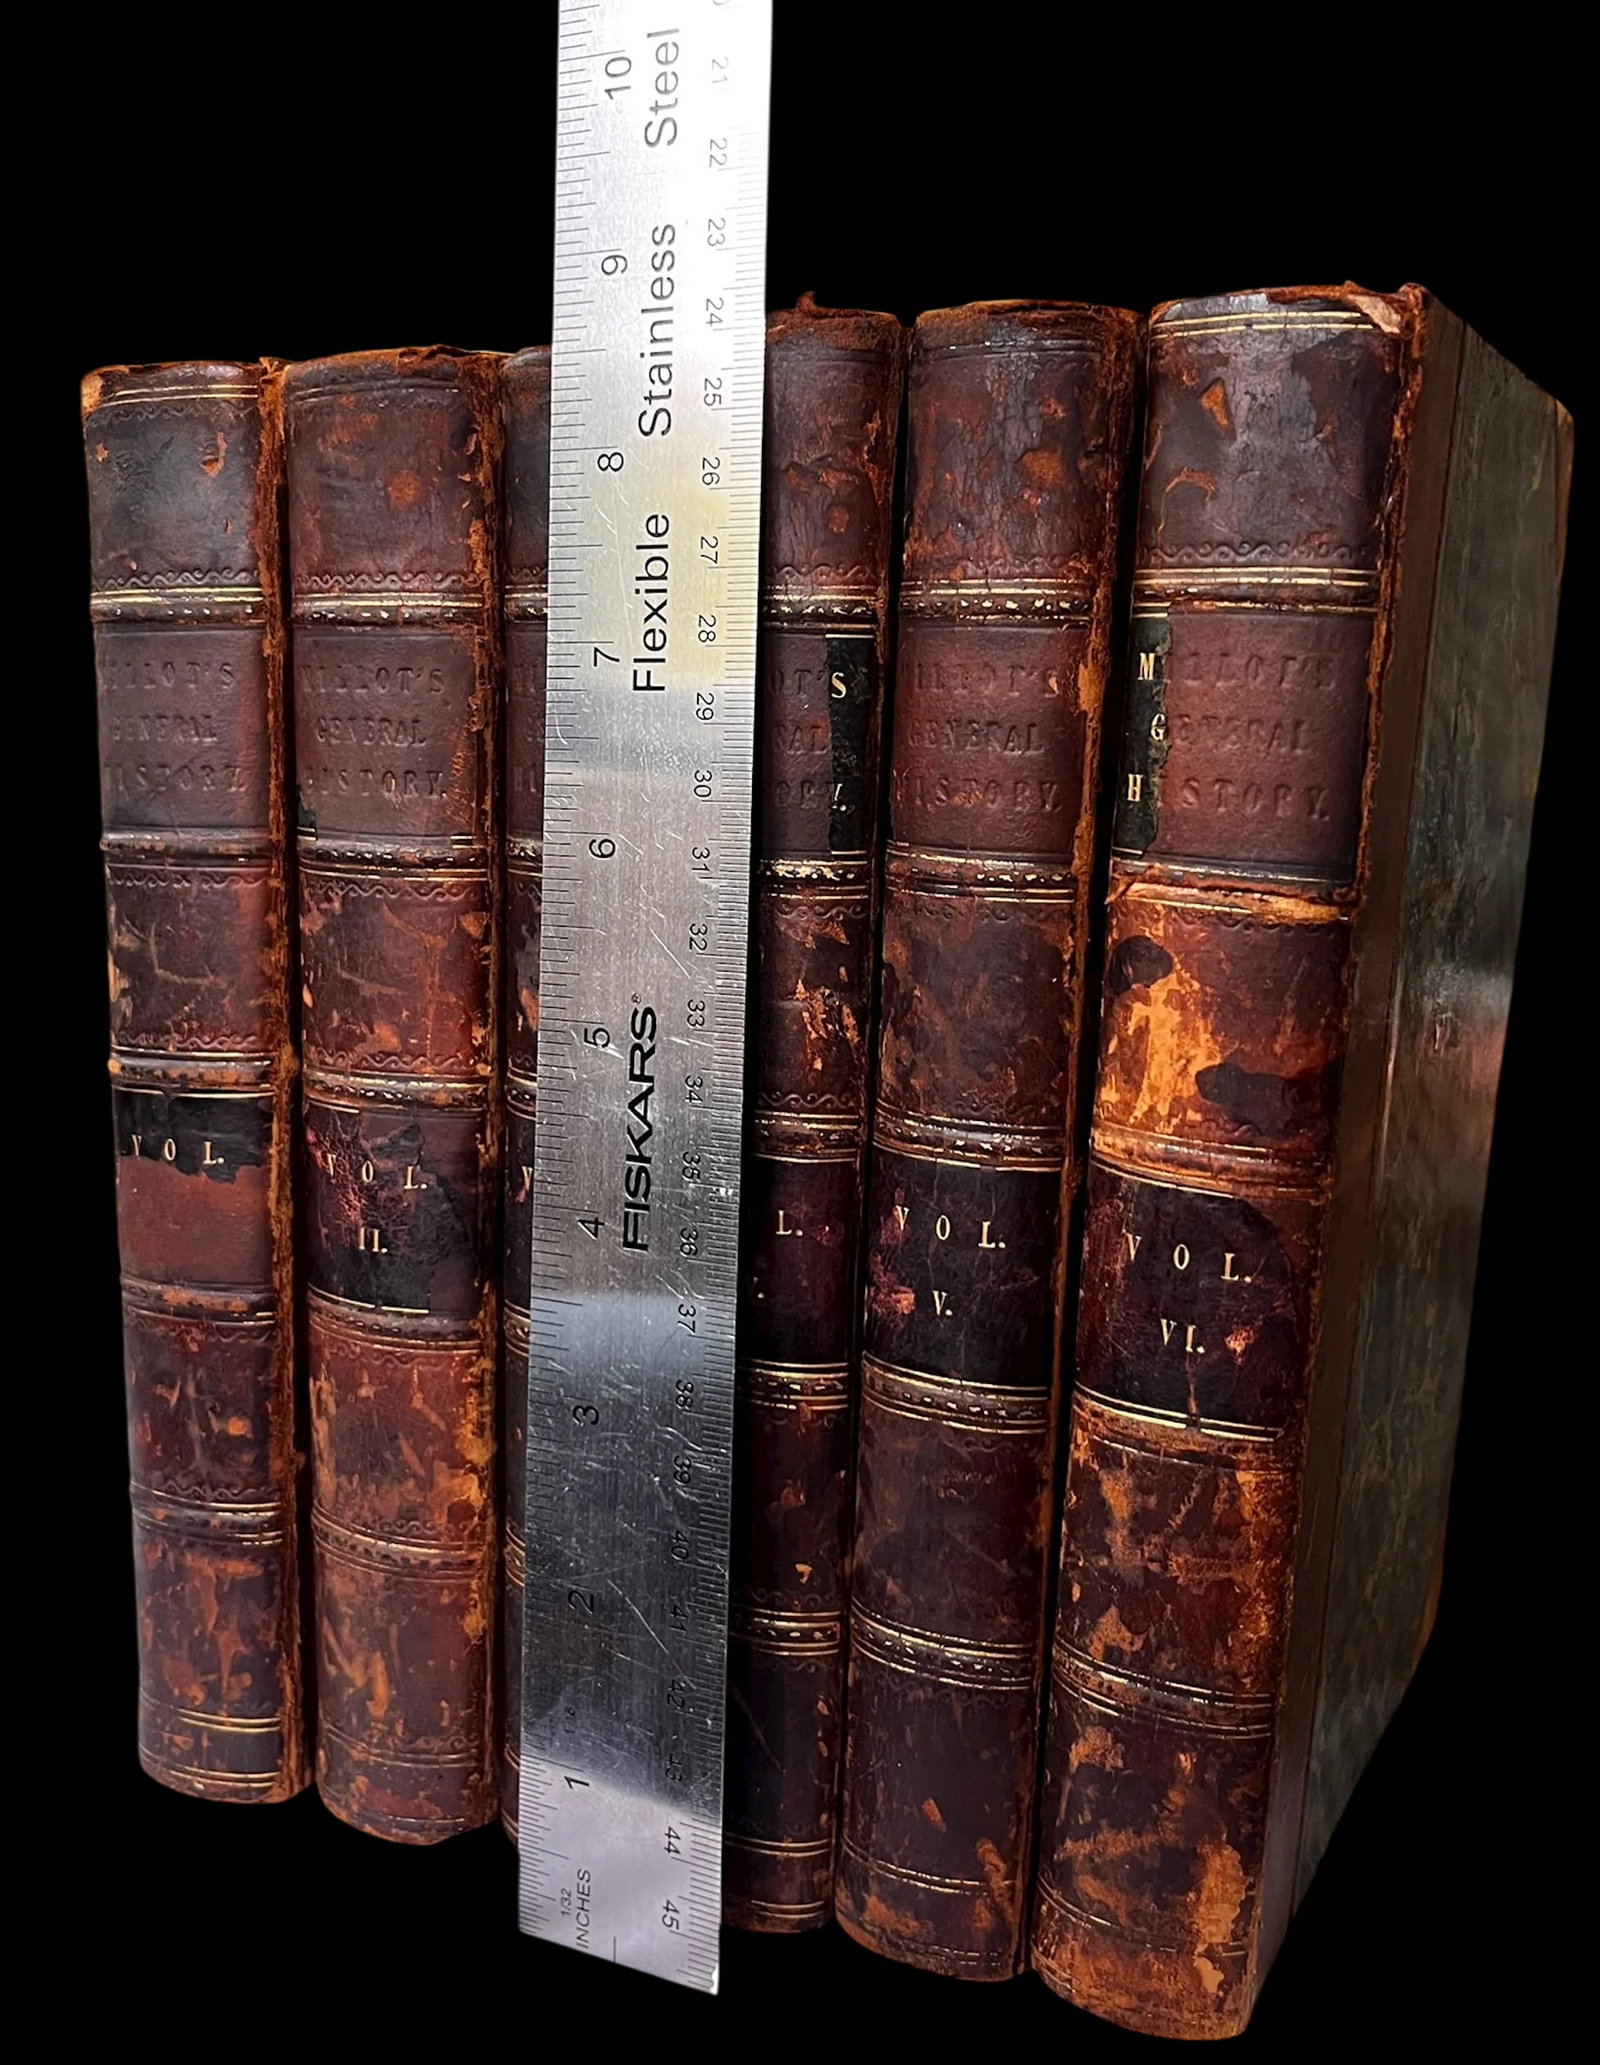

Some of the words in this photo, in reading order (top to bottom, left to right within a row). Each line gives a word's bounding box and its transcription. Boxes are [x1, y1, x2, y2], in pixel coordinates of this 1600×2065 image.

[604, 55, 631, 100] 10
[711, 56, 729, 84] 21
[644, 28, 679, 148] Steel
[708, 137, 728, 168] 22
[707, 217, 726, 247] 23
[600, 254, 627, 276] 9
[705, 297, 724, 327] 24
[638, 224, 676, 436] Stainless
[703, 377, 722, 407] 25
[597, 452, 624, 472] 8
[702, 457, 720, 486] 26
[700, 535, 718, 564] 27
[632, 513, 669, 692] Flexible
[698, 614, 716, 643] 28
[593, 647, 620, 667] 7
[696, 692, 714, 721] 29
[693, 769, 712, 798] 30
[588, 838, 616, 859] 6
[692, 847, 709, 873] 31
[689, 923, 708, 951] 32
[687, 999, 706, 1027] 33
[583, 1027, 610, 1049] 5
[685, 1075, 703, 1103] 34
[132, 1134, 225, 1166] VOL.
[326, 1153, 427, 1190] VOL.
[682, 1152, 701, 1181] 35
[357, 1227, 388, 1254] II.
[578, 1217, 605, 1240] 4
[895, 1205, 1006, 1249] VOL.
[680, 1228, 698, 1256] 36
[1126, 1232, 1252, 1283] VOL.
[932, 1290, 953, 1317] V.
[678, 1303, 696, 1334] 37
[1160, 1318, 1205, 1354] VI.
[675, 1380, 694, 1409] 38
[573, 1405, 599, 1426] 3
[673, 1456, 692, 1485] 39
[671, 1532, 689, 1560] 40
[568, 1590, 594, 1615] 2
[670, 1604, 688, 1632] 41
[667, 1679, 685, 1709] 42
[564, 1774, 590, 1790] 1
[664, 1826, 682, 1855] 44
[560, 1887, 572, 1918] 1/32
[576, 1868, 591, 1949] INCHES
[662, 1899, 680, 1930] 45
